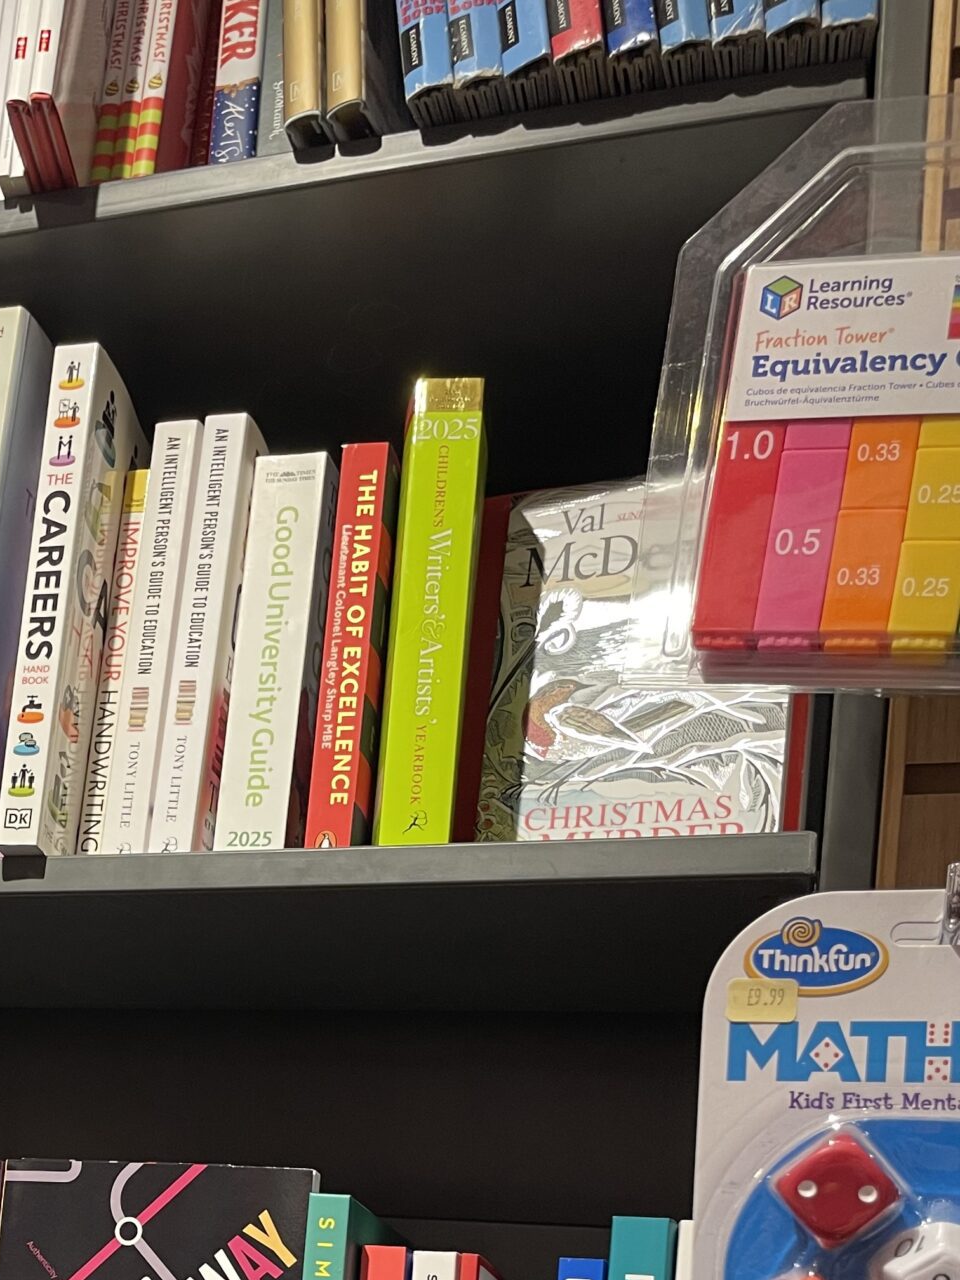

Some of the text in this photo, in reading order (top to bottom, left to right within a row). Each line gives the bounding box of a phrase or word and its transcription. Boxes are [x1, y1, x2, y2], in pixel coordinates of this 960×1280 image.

[505, 6, 514, 44] EGMONT
[410, 29, 418, 65] EGMONT
[809, 276, 893, 294] Learning
[755, 326, 888, 352] Fraction Tower
[752, 350, 948, 382] Equivalency
[746, 388, 775, 396] Cubos
[790, 384, 845, 395] equivalencia
[889, 382, 916, 390] Tower
[726, 430, 774, 460] 1.0
[48, 473, 73, 486] THE
[774, 529, 821, 556] 0.5
[26, 490, 69, 661] CAREERS
[902, 577, 949, 597] 0.25
[329, 470, 379, 805] THE HABIT OF EXCELLENCE
[246, 505, 300, 807] Good University Guide
[22, 665, 50, 675] HAND
[21, 676, 49, 686] BOOK
[7, 811, 30, 826] DK
[227, 831, 272, 848] 2025
[747, 987, 786, 1008] £9.99
[789, 1091, 893, 1111] Kid's First
